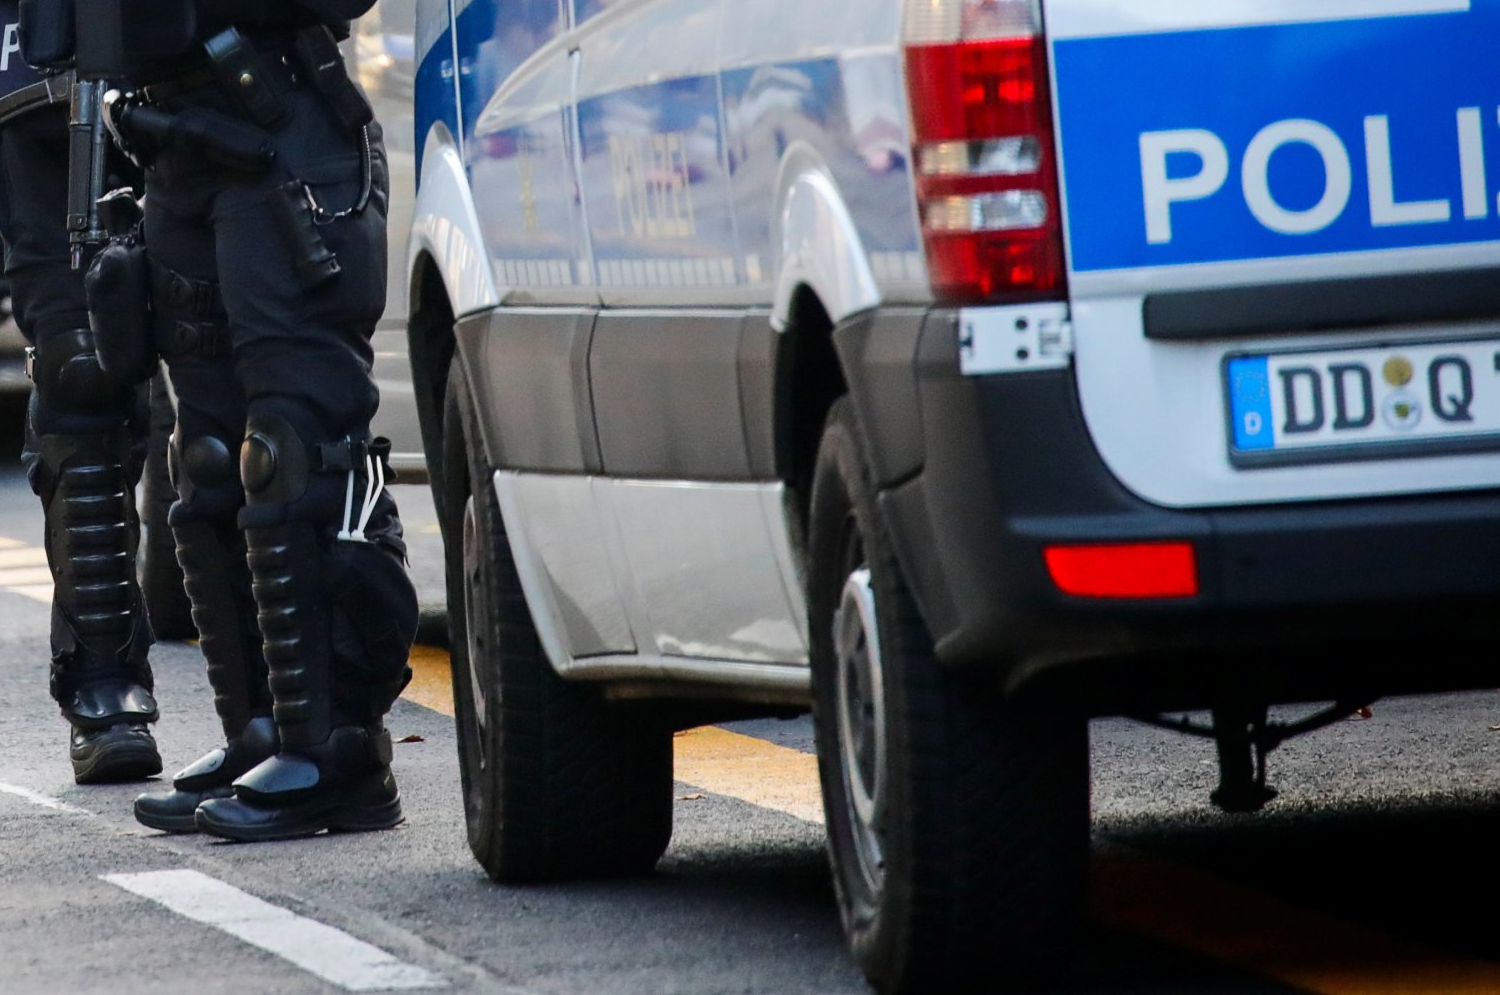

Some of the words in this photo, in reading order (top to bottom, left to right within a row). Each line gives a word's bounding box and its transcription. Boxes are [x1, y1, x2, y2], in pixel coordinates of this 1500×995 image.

[1139, 104, 1500, 244] POLI
[1278, 361, 1375, 434] DD
[1428, 355, 1474, 422] Q
